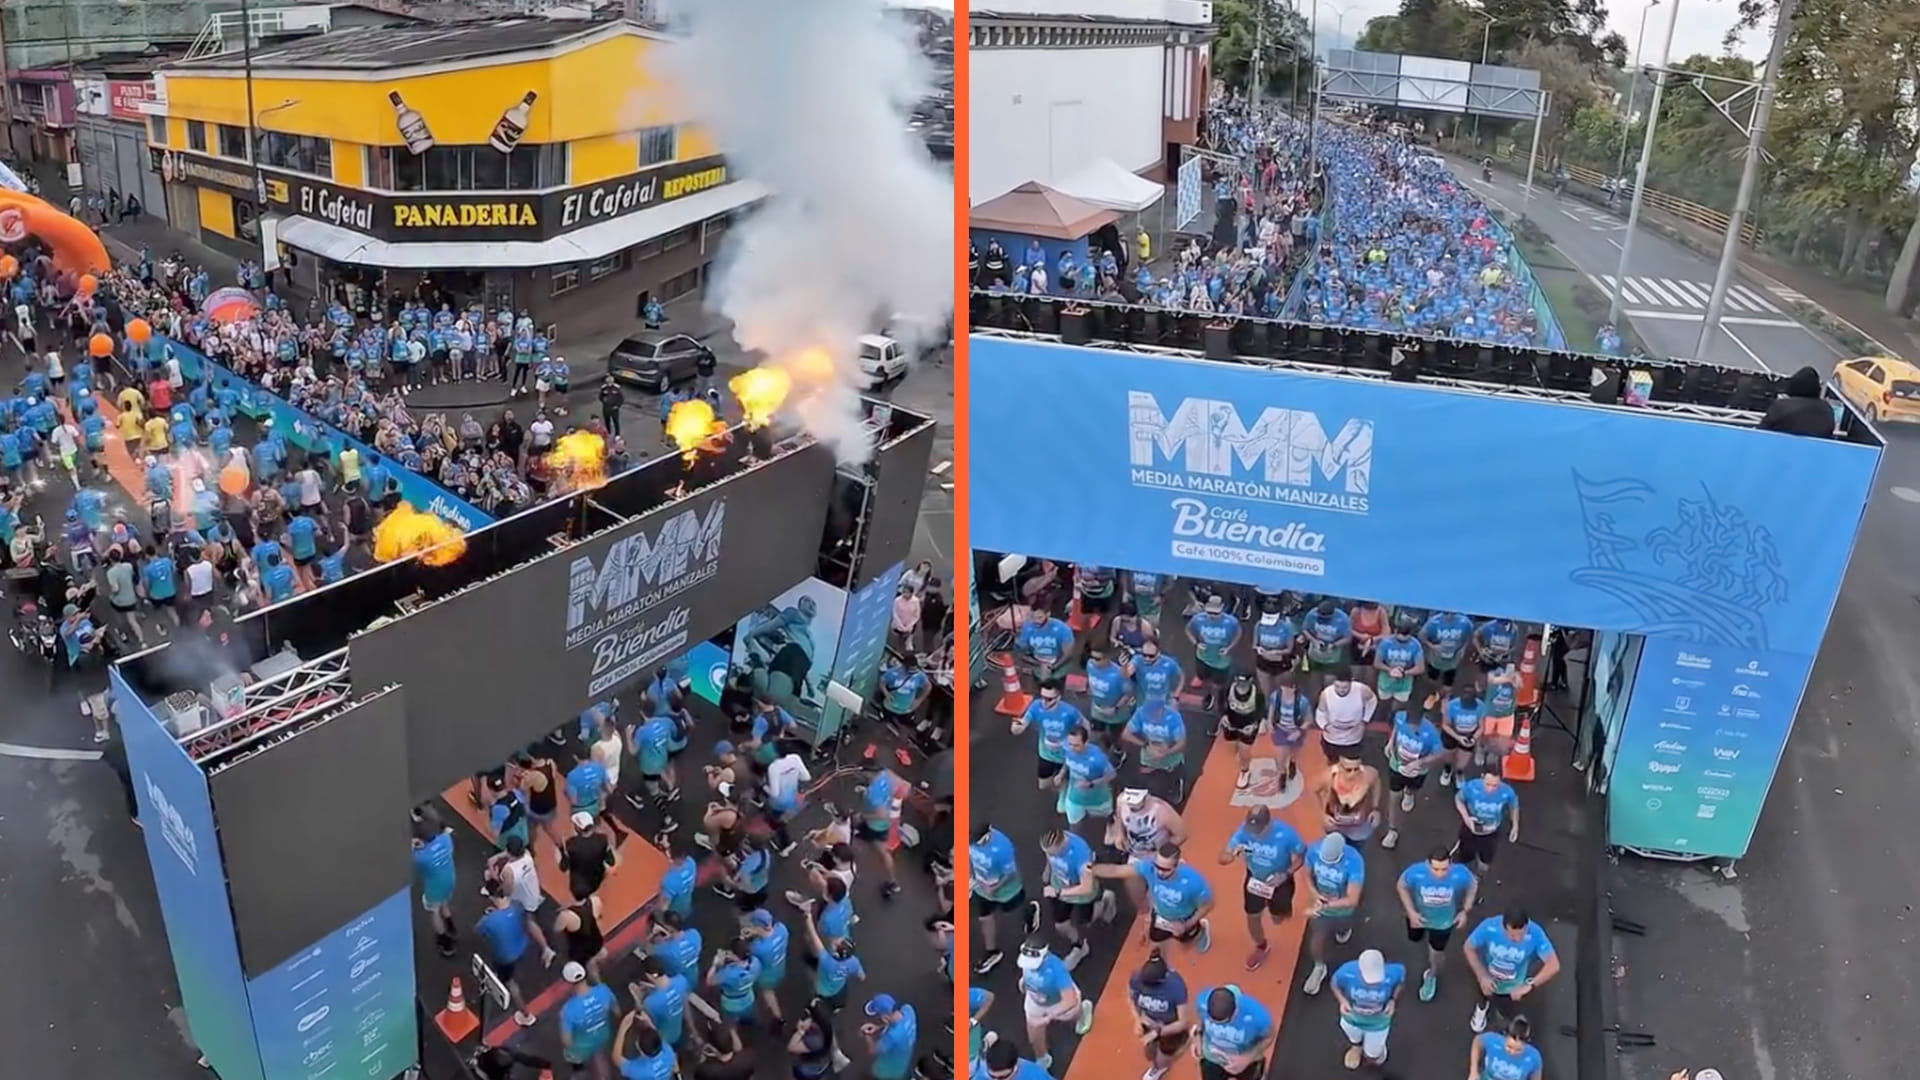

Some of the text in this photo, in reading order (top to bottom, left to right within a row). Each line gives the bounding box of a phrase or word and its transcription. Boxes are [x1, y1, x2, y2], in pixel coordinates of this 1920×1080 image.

[300, 186, 313, 213] El
[318, 188, 374, 231] Cafetal
[393, 203, 537, 227] PANADERIA
[562, 176, 657, 227] El Cafetal
[1128, 390, 1375, 494] MMM
[1130, 469, 1369, 511] MEDIA MARATÓN MANIZALES
[1210, 505, 1249, 522] Café
[1171, 497, 1325, 553] Buendía
[566, 500, 726, 631] MMM
[1176, 543, 1320, 573] Café 100% Colombiano
[565, 560, 719, 648] MEDIA MARATÓN MANIZALES
[591, 605, 690, 676] Buendía
